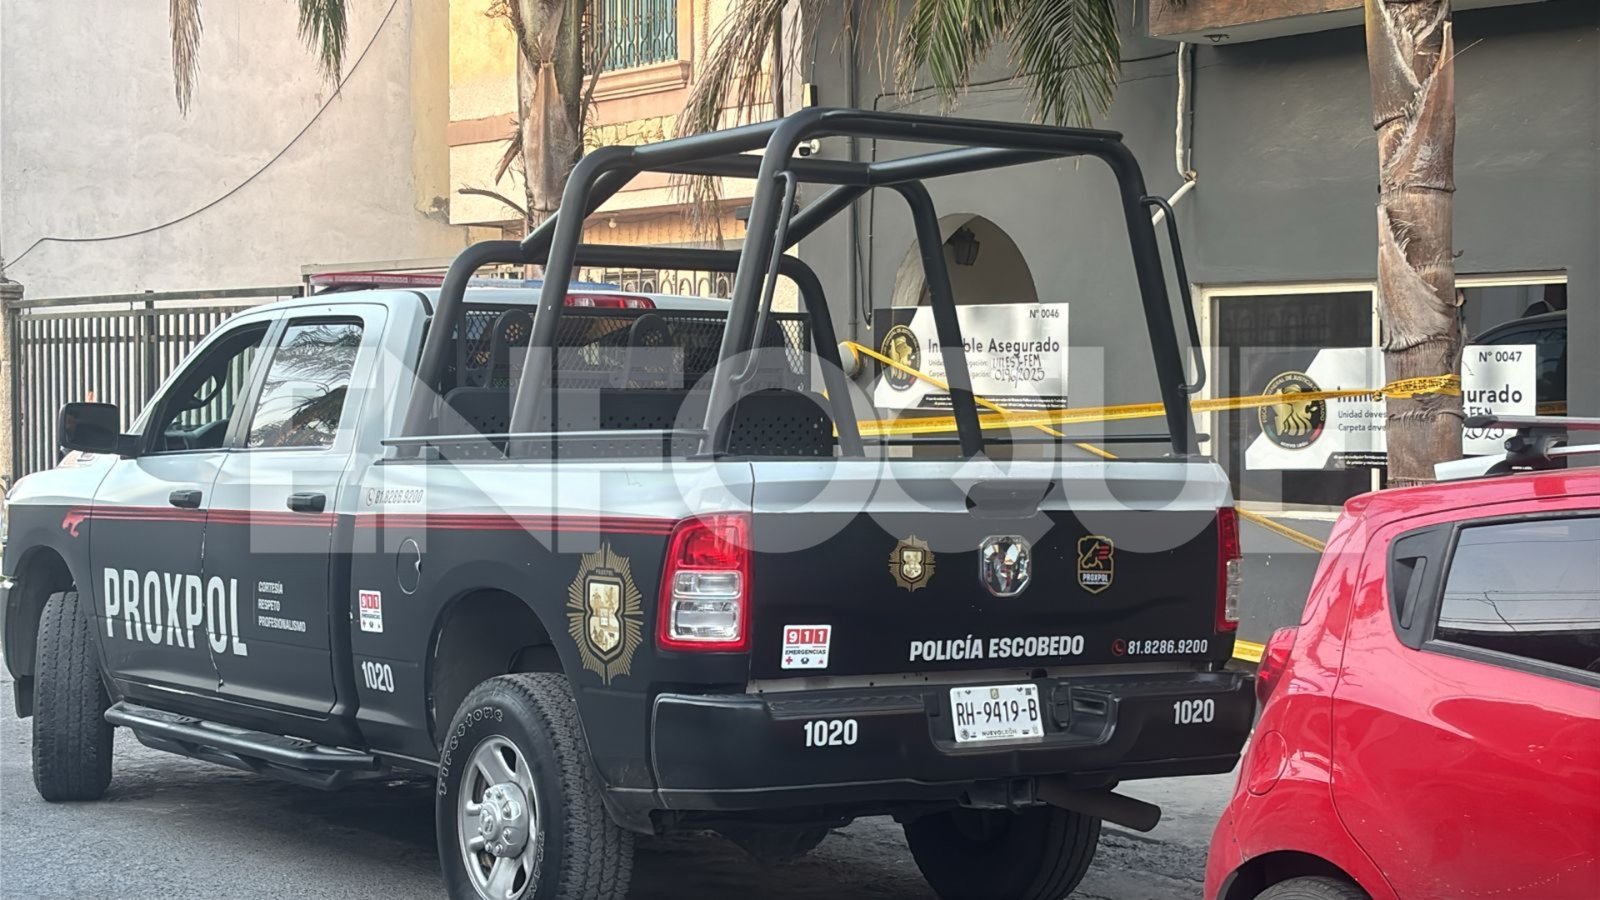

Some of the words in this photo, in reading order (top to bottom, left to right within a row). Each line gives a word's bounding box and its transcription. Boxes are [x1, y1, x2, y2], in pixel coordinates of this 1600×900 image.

[1040, 308, 1060, 319] 0046
[928, 337, 983, 353] Inble
[988, 337, 1060, 358] Asegurado
[1495, 351, 1522, 363] 0047
[1462, 384, 1522, 403] urado
[1338, 409, 1363, 419] Unidad
[1338, 423, 1365, 434] Carpeta
[1082, 573, 1108, 582] PROXPOL
[258, 580, 284, 594] CORTESÍA
[258, 598, 281, 611] RESPETO
[361, 595, 379, 608] 911
[104, 567, 248, 656] PROXPOL
[258, 615, 306, 632] PROFESIONALISMO
[788, 630, 825, 643] 911
[909, 634, 983, 661] POLICÍA
[988, 635, 1085, 659] ESCOBEDO
[1127, 639, 1208, 655] 81.8286.9200
[361, 661, 395, 693] 1020
[955, 699, 1038, 726] RH-9419-B
[1173, 699, 1215, 725] 1020
[803, 719, 858, 747] 1020
